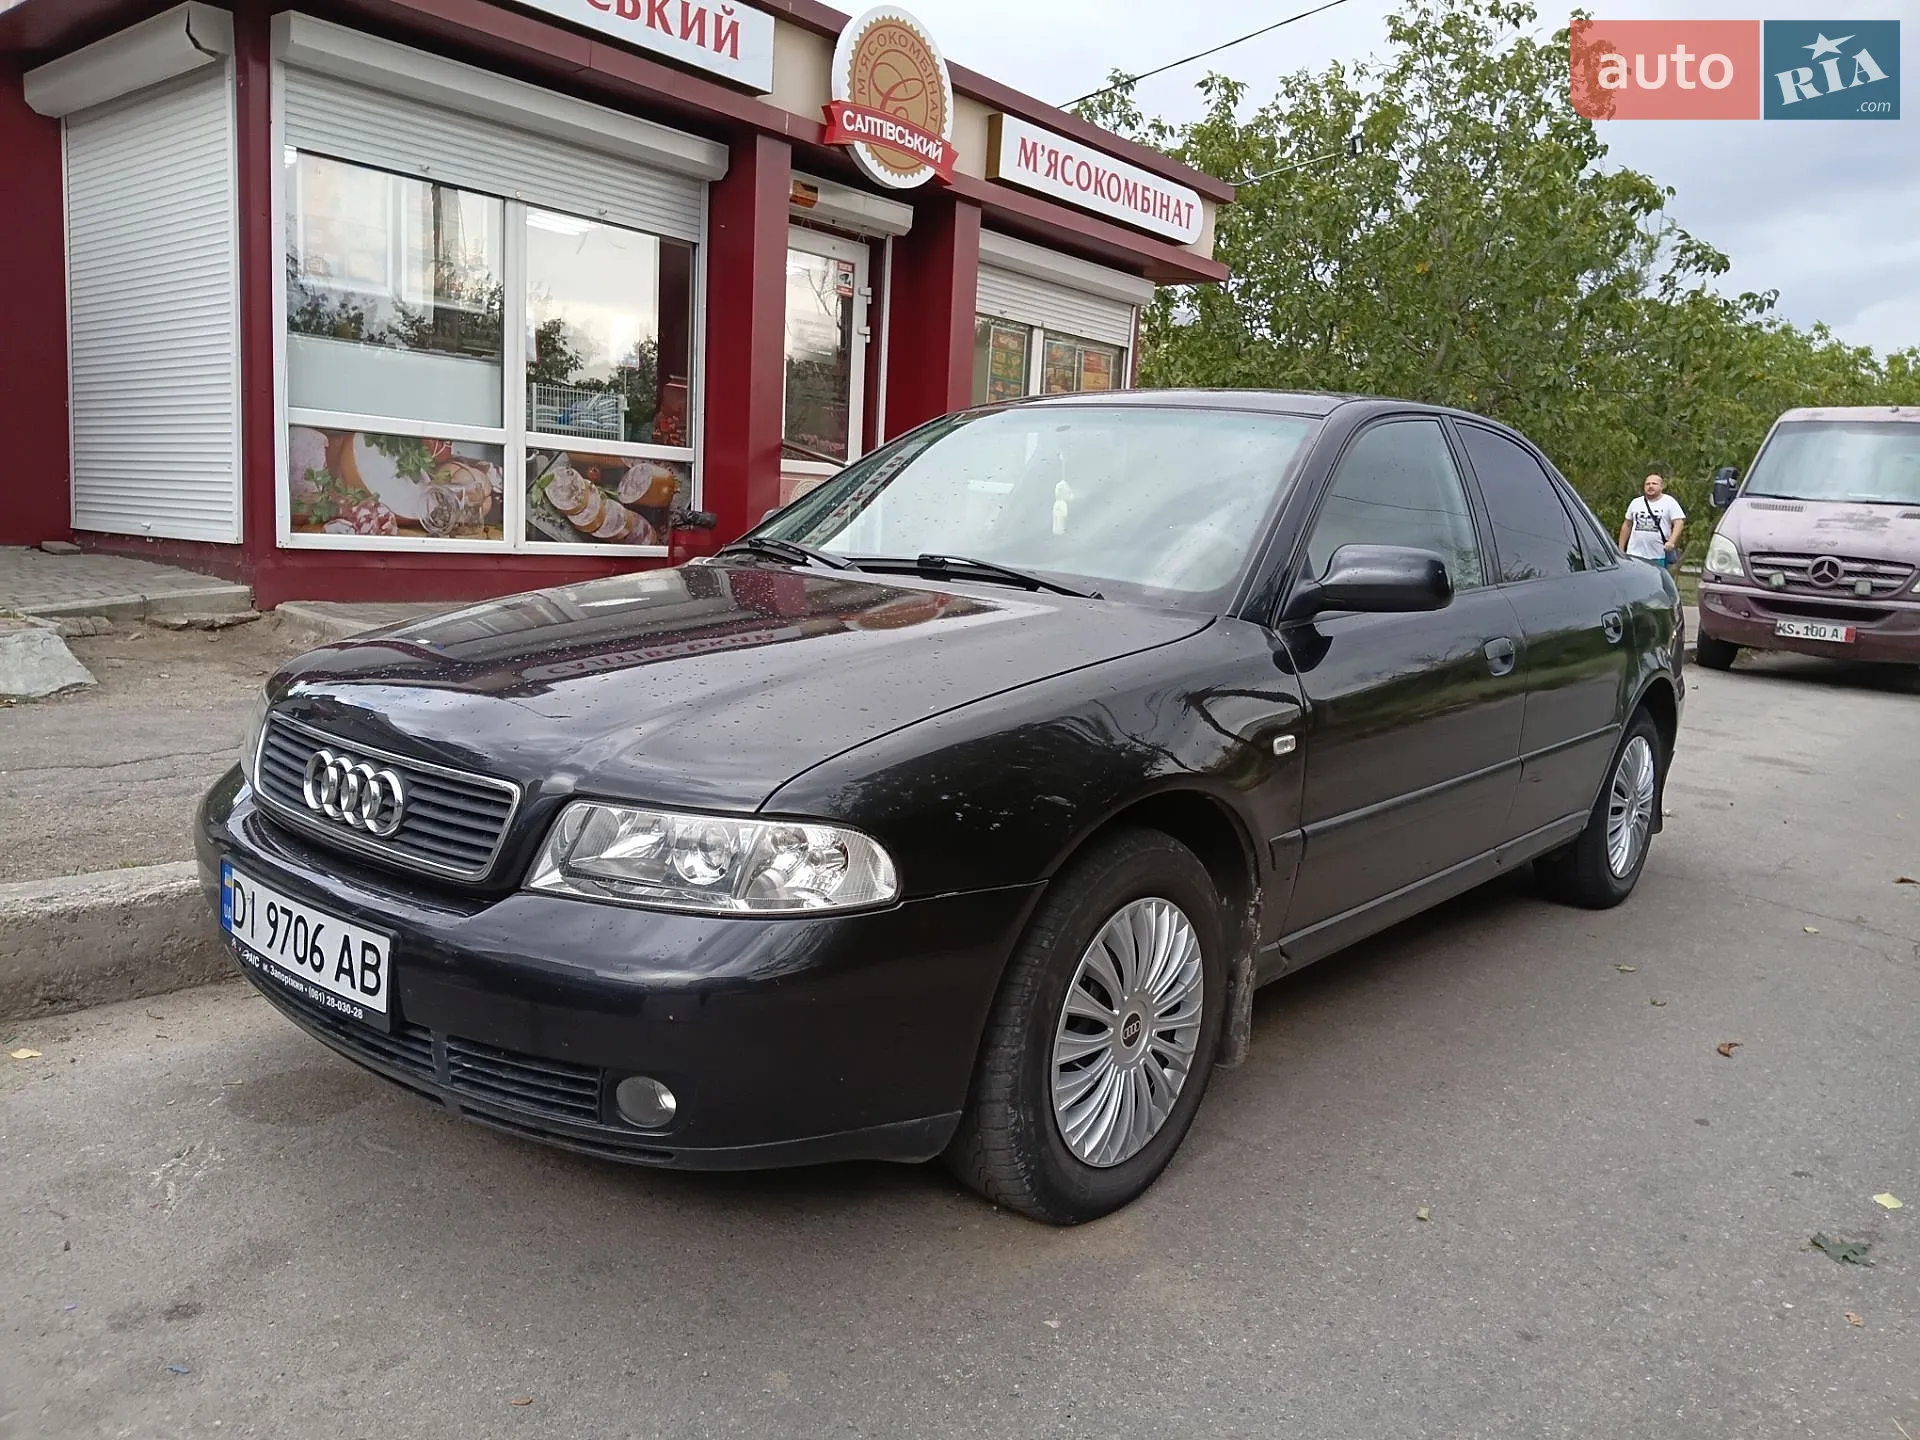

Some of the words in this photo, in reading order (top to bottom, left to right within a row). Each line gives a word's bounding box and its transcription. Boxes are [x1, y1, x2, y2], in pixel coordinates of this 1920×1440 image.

[842, 110, 943, 164] САЛТІВСЬКИЙ
[1017, 136, 1195, 230] М'ЯСОКОМБІНАТ
[233, 879, 255, 939] DI
[266, 901, 325, 973] 9706
[334, 934, 382, 997] AB
[326, 995, 364, 1020] 28-030-28
